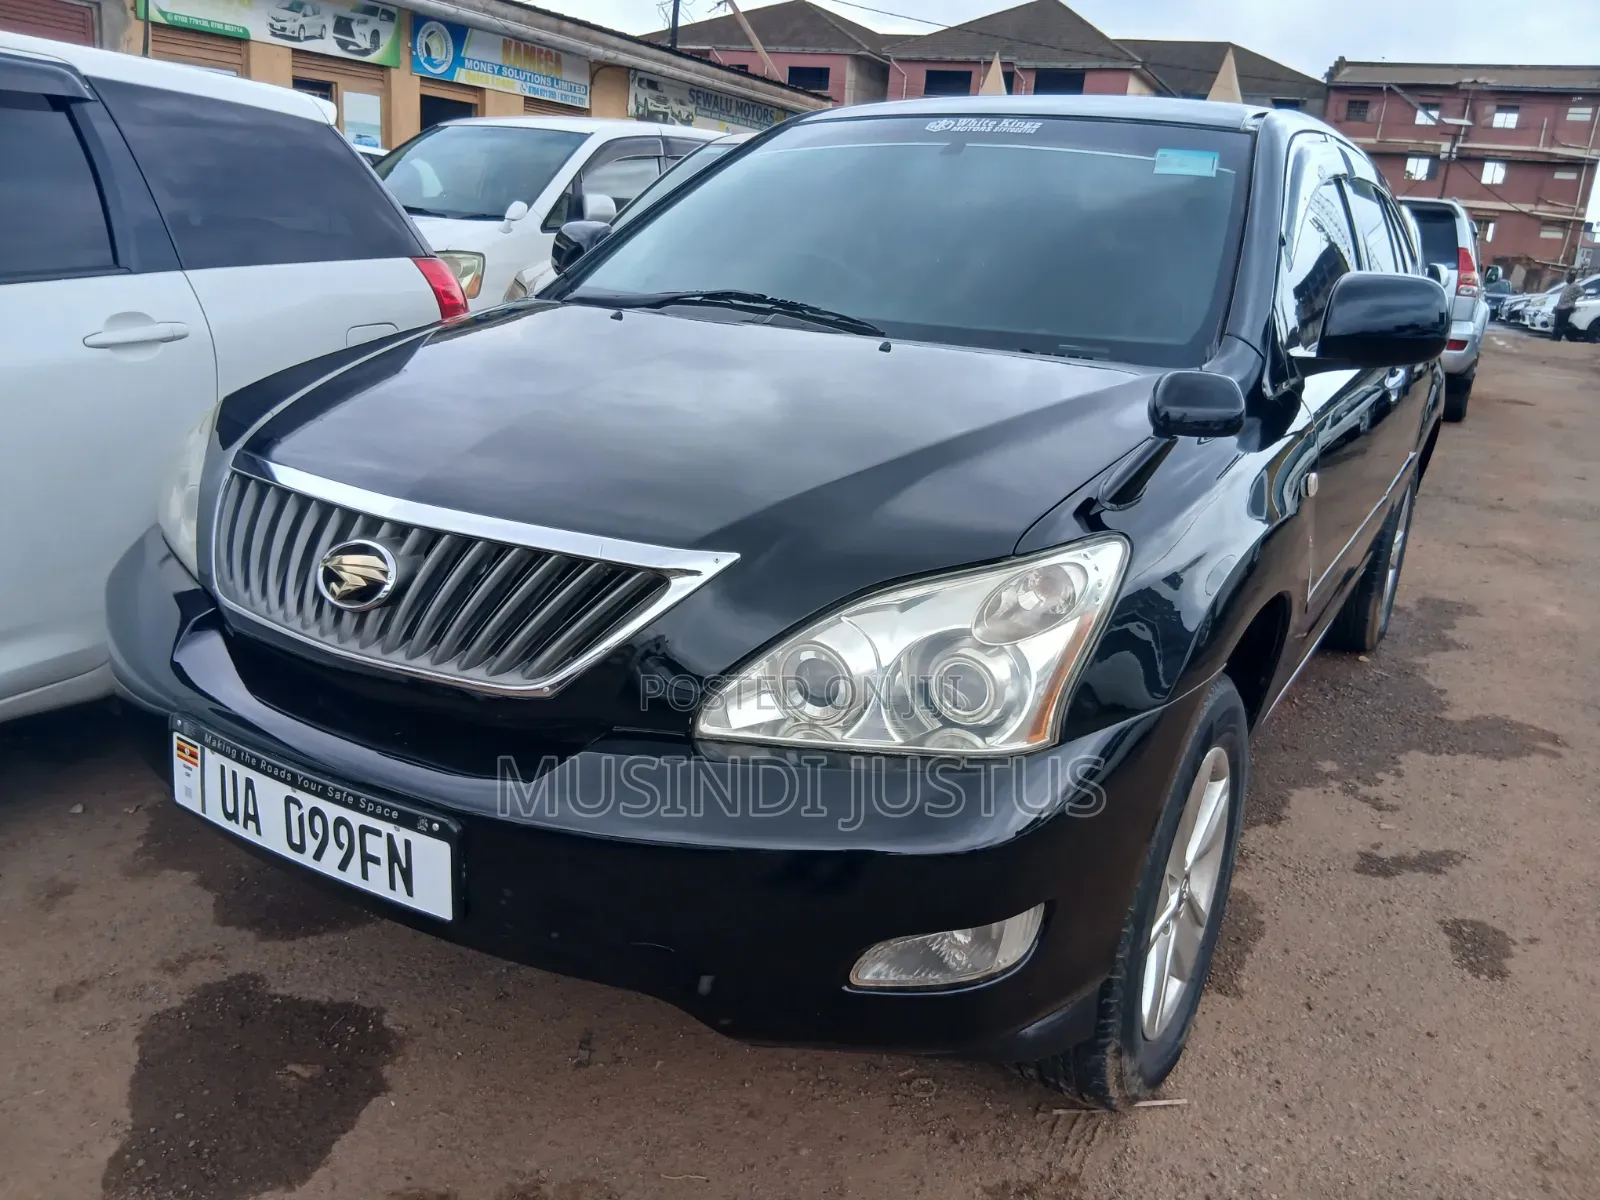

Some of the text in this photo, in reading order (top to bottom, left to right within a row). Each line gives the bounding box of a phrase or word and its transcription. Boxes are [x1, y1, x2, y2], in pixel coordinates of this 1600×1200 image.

[464, 58, 586, 95] MONEY SOLUTIONS LIMITED
[688, 88, 775, 124] SEWALU MOTORS
[956, 118, 997, 127] White
[204, 733, 400, 820] Making the Roads Your Safe Space
[220, 763, 415, 898] UA 099FN
